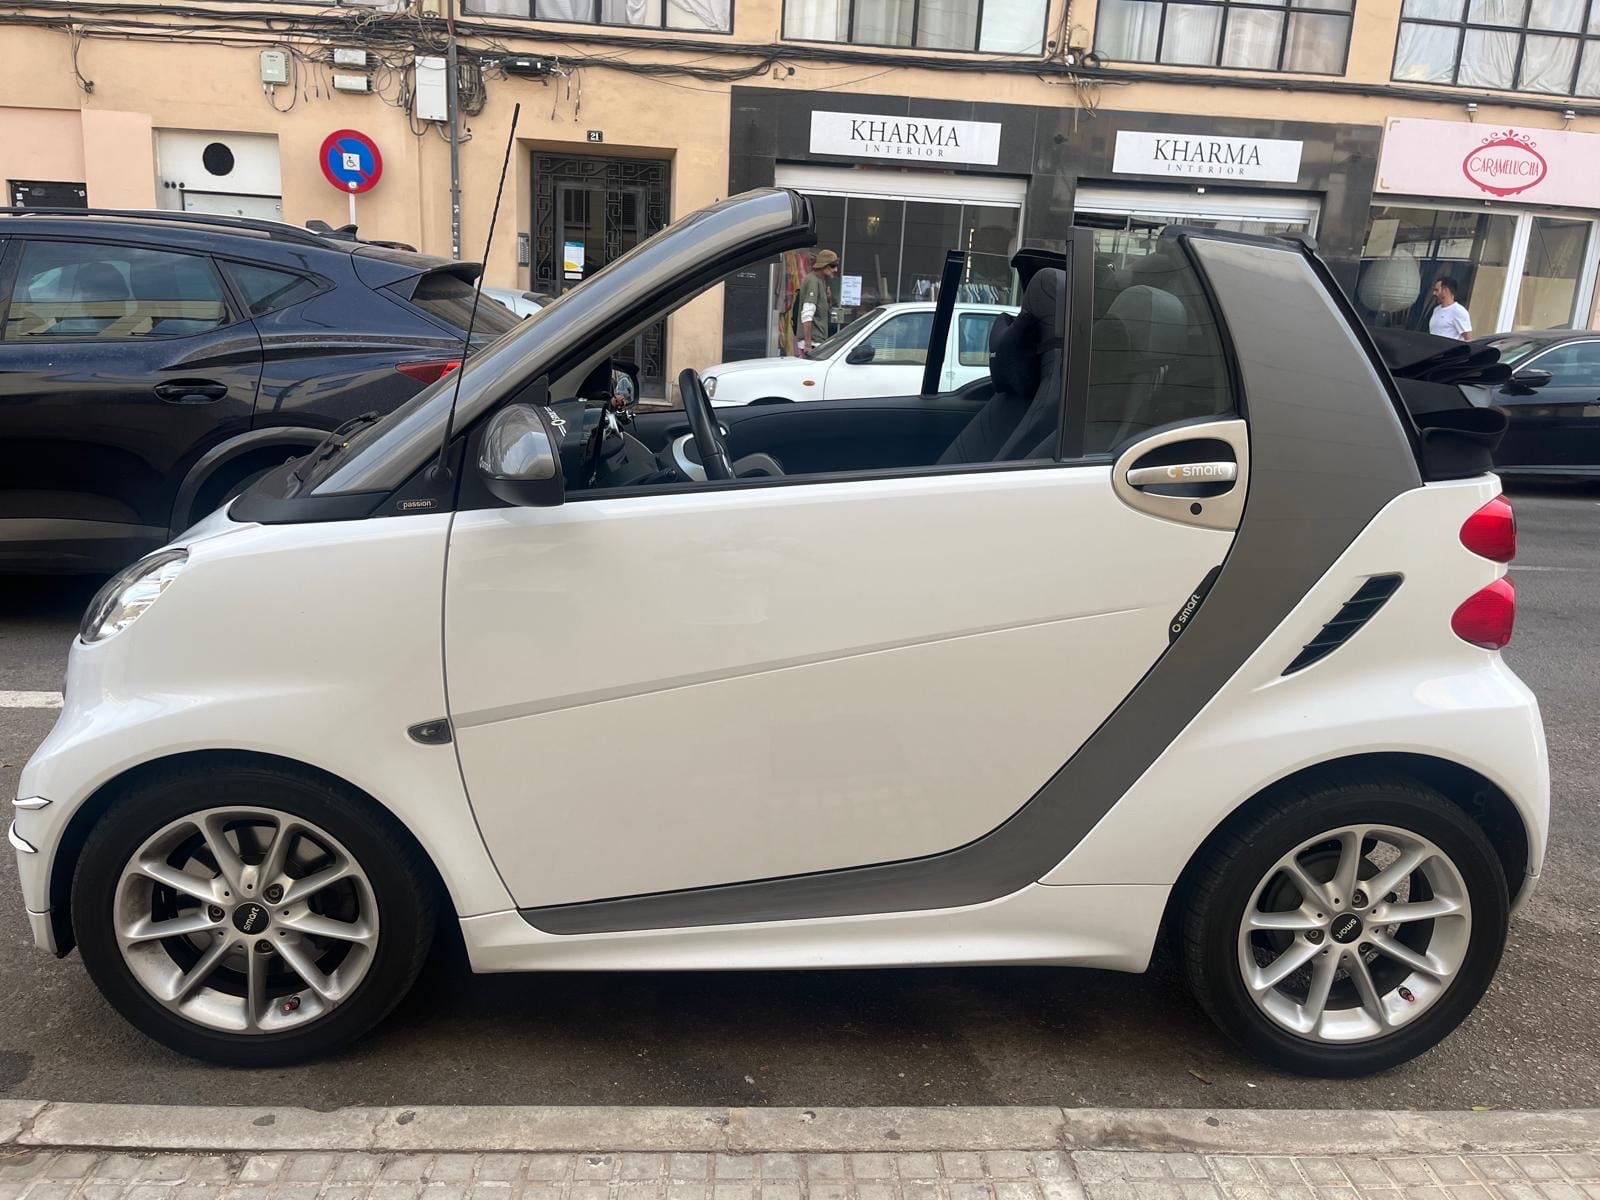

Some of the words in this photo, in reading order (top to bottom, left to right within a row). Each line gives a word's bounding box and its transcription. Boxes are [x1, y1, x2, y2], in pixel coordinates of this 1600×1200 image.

[590, 132, 599, 141] 21
[850, 119, 961, 147] KHARMA
[865, 143, 945, 158] INTERIOR
[1153, 139, 1262, 166] KHARMA
[1167, 163, 1246, 176] INTERIOR
[1469, 156, 1540, 177] CARAMELUCHA
[402, 500, 432, 510] passion
[1178, 594, 1201, 624] smart
[243, 907, 260, 931] smart
[1335, 918, 1357, 939] smart
